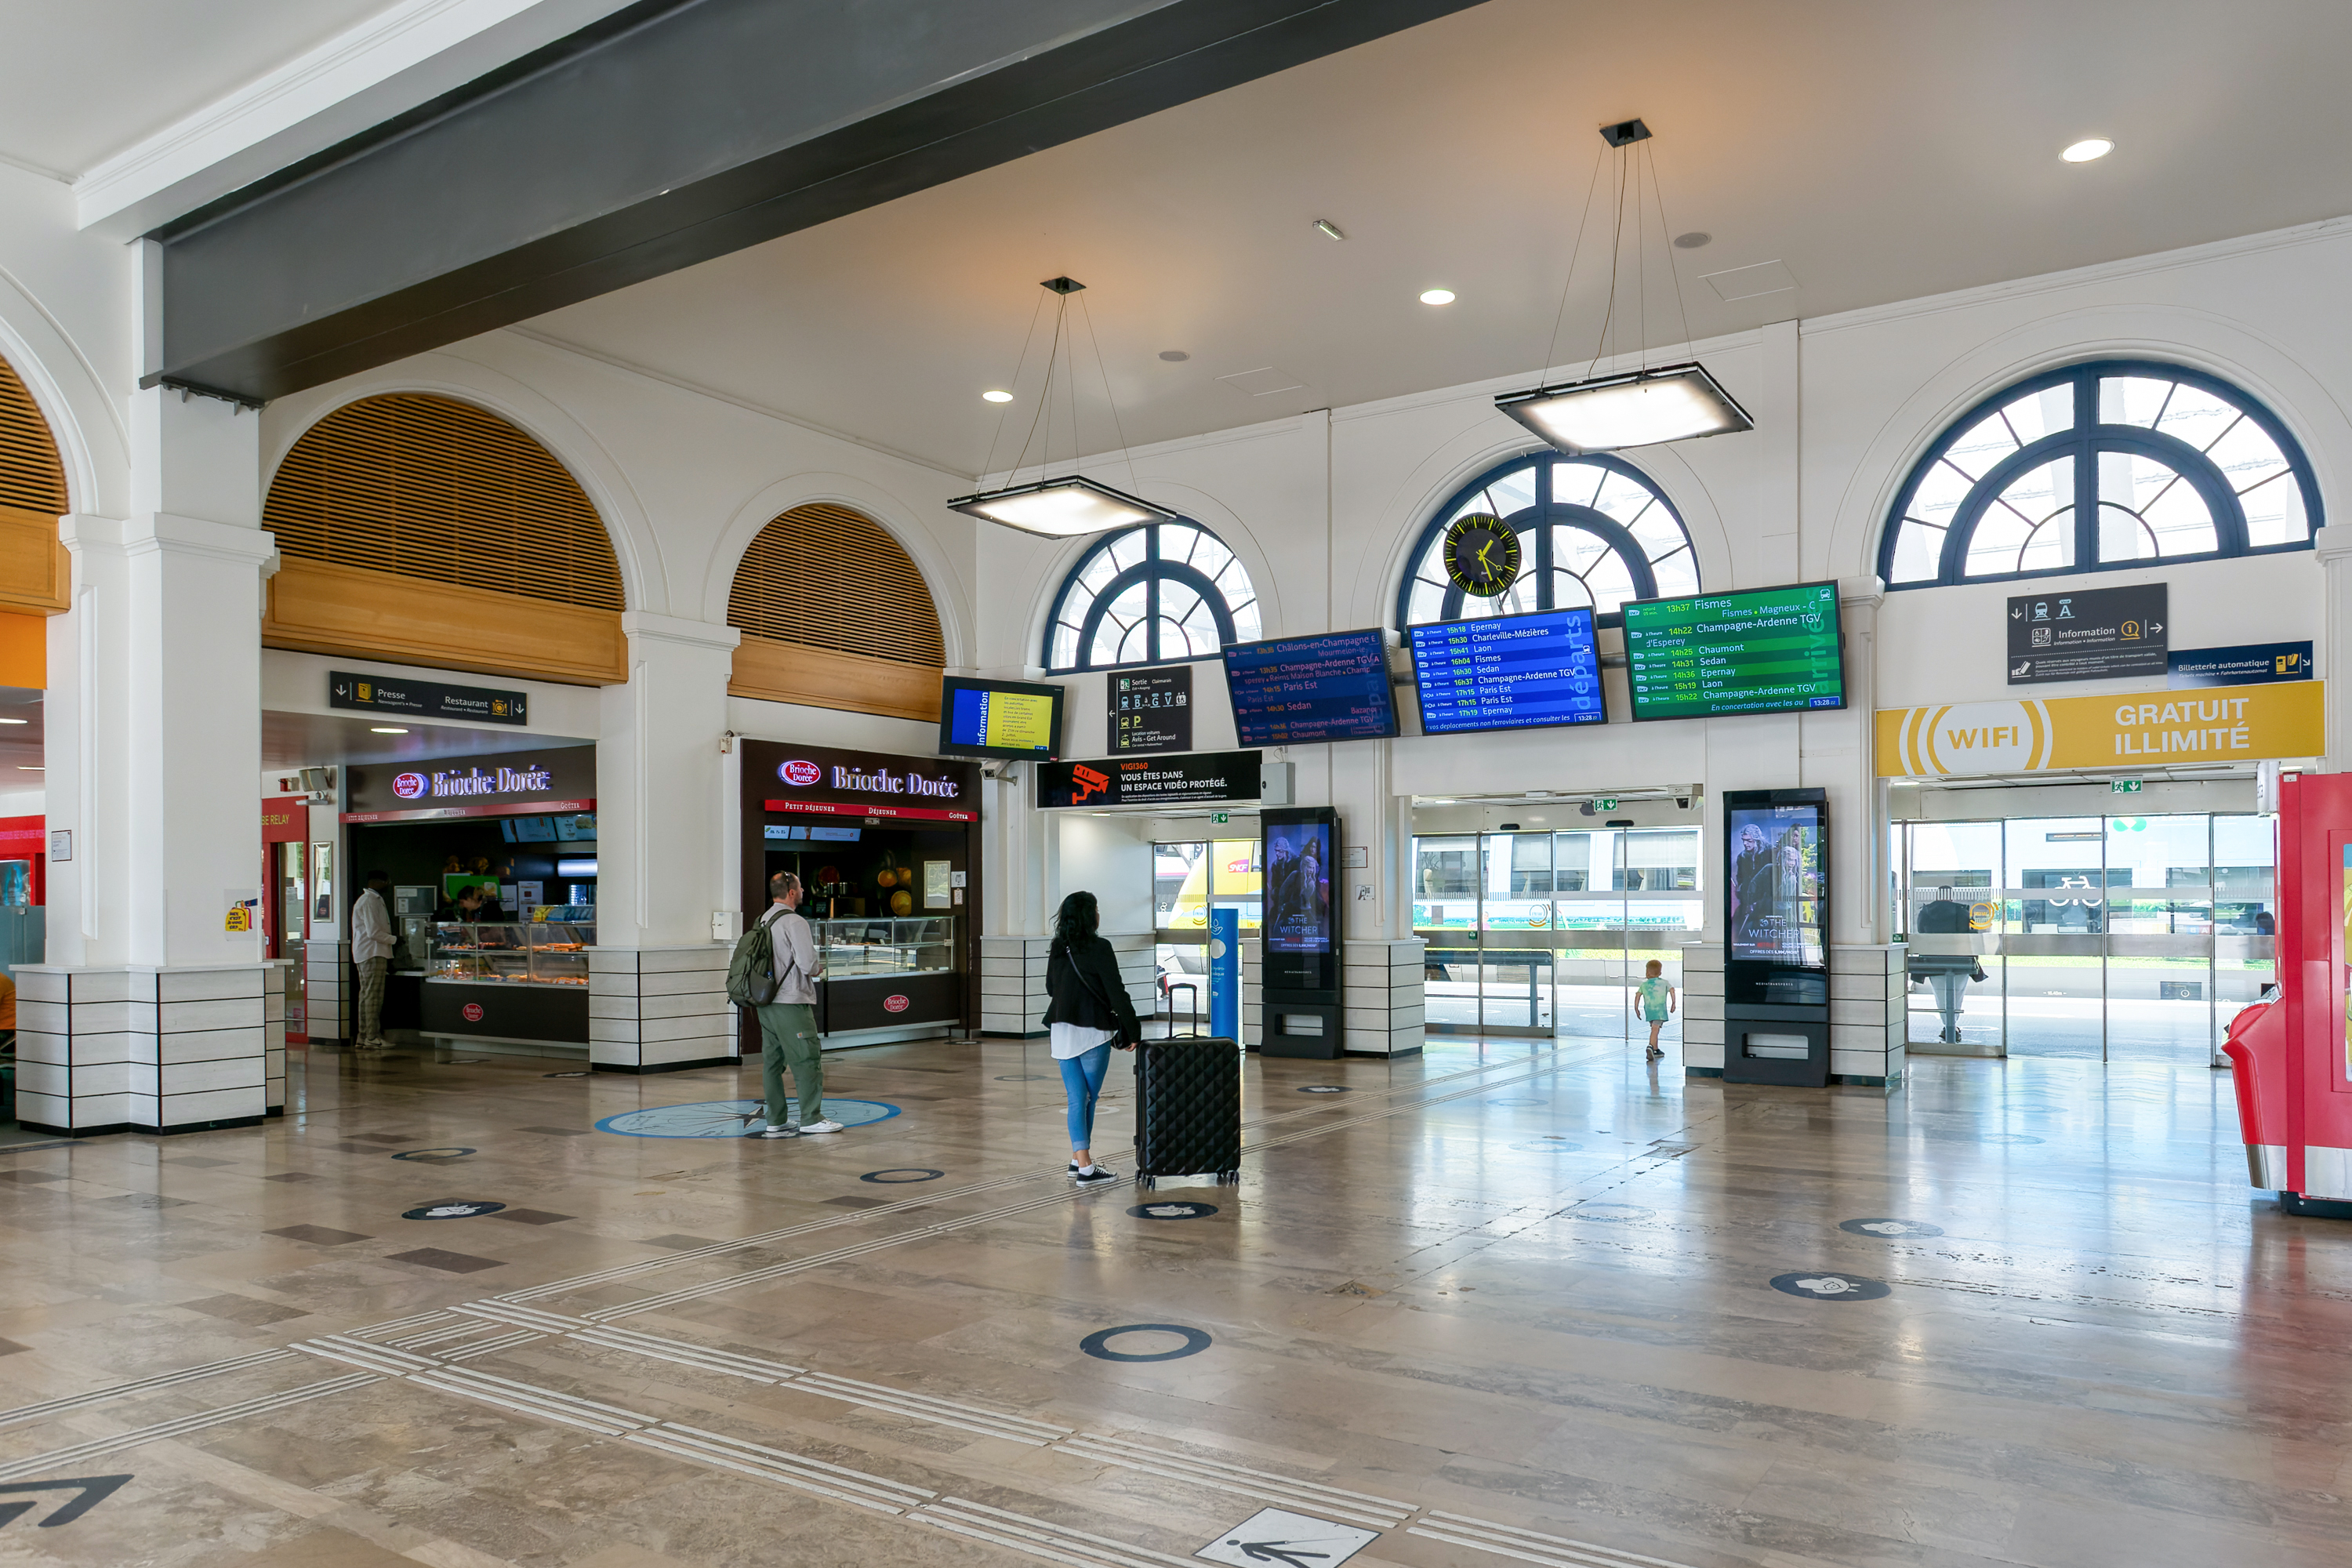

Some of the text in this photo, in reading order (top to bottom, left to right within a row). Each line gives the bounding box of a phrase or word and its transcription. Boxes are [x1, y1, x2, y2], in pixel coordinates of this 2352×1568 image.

[1666, 603, 1690, 613] 13h37
[1694, 599, 1732, 610] Fismes
[1722, 601, 1816, 618] Fismes Magneux C
[2060, 604, 2071, 617] A
[1471, 622, 1501, 633] Epernay
[1668, 613, 1821, 636] 14h22 Champagne-Ardenne TGV
[1472, 628, 1549, 642] Charleville-Mézières
[2059, 627, 2115, 639] Information
[1276, 636, 1370, 652] Châlons-en-Champagne
[1646, 638, 1686, 648] d'Esperey
[1671, 643, 1744, 657] 14h25 Chaumont
[1259, 666, 1278, 674] 13h35
[1279, 659, 1356, 672] Champagne-Ardenne
[1356, 655, 1373, 664] TGV
[1475, 654, 1501, 663] Fismes
[1565, 615, 1593, 710] départs
[1671, 656, 1726, 668] 14h31 Sedan
[1476, 665, 1500, 674] Sedan
[2178, 659, 2270, 672] Billetterie automatique
[1315, 669, 1341, 678] Blanche
[1478, 671, 1558, 684] Champagne-Ardenne
[1559, 668, 1575, 677] TGV
[1673, 668, 1737, 679] 14h36 Epernay
[1283, 681, 1303, 691] Paris
[1304, 681, 1318, 690] Est
[1479, 686, 1497, 695] Paris
[1674, 680, 1722, 690] 15h19 Laon
[1703, 687, 1795, 699] Champagne-Ardenne
[1797, 683, 1816, 693] TGV
[378, 688, 405, 699] Presse
[445, 695, 488, 709] Restaurant
[1134, 699, 1141, 708] B
[1152, 697, 1159, 706] G
[1164, 696, 1171, 706] V
[1287, 701, 1312, 711] Sedan
[1481, 696, 1499, 705] Paris
[1721, 701, 1764, 710] concertation
[1483, 707, 1513, 717] Epernay
[2115, 697, 2250, 726] GRATUIT
[977, 691, 989, 746] information
[1134, 715, 1141, 727] P
[1290, 717, 1359, 729] Champagne-Ardenne
[1439, 721, 1479, 730] deplacements
[1492, 717, 1525, 726] ferroviaires
[1533, 714, 1561, 723] consulter
[1292, 730, 1327, 739] Chaumont
[1947, 725, 2018, 750] WIFI
[2115, 720, 2250, 755] ILLIMITÉ
[789, 764, 817, 776] Brioche
[397, 776, 417, 787] Brioche
[431, 764, 550, 797] Brioche Dorée
[793, 773, 813, 782] Dorée
[832, 765, 959, 798] Brioche Dorée
[1120, 771, 1183, 782] VOUS ÊTES DANS
[399, 786, 415, 795] Dorée
[1120, 778, 1228, 792] UN ESPACE VIDÉO PROTÉGÉ.
[560, 801, 579, 810] GOÛTER
[805, 804, 835, 812] DÉJEUNER
[869, 807, 897, 815] DÉJEUNER
[270, 814, 290, 826] RELAY
[1229, 863, 1248, 872] SNCF
[1279, 926, 1318, 935] WITCHER
[1748, 929, 1801, 939] WITCHER
